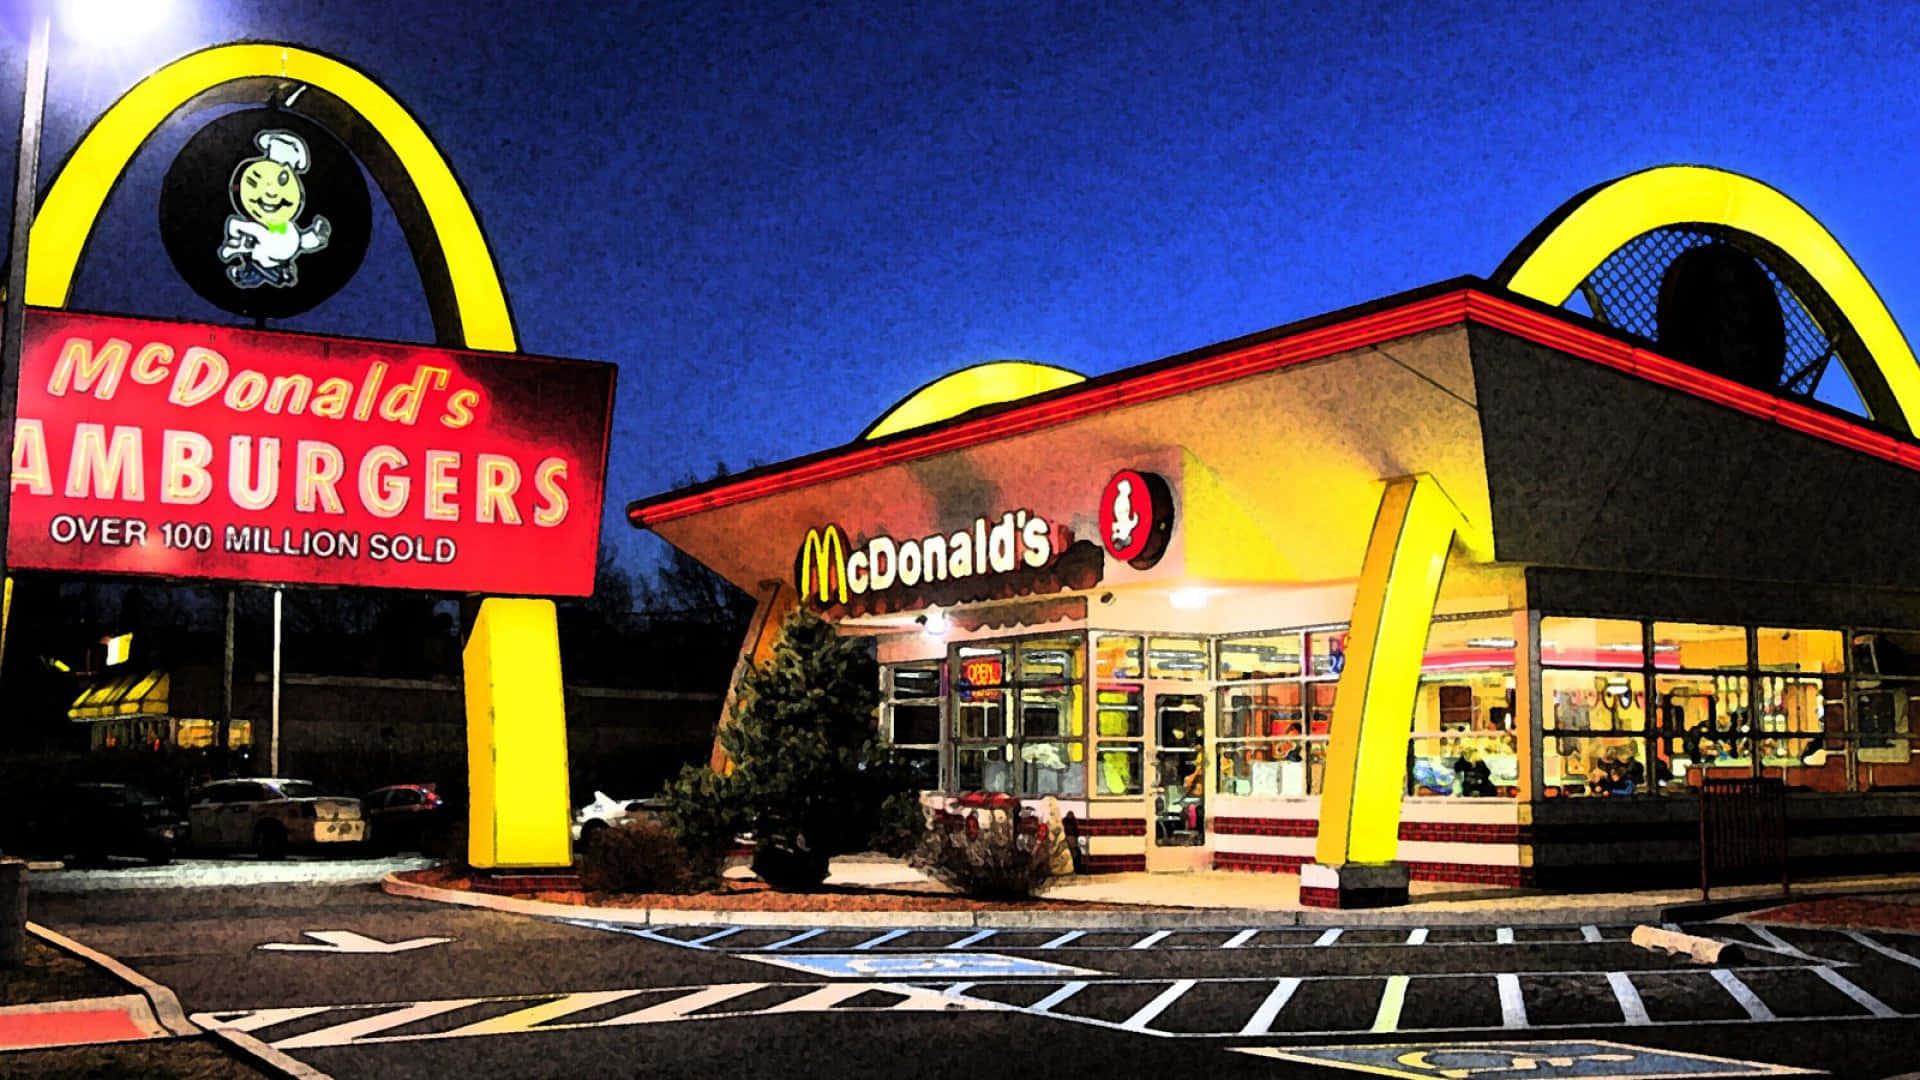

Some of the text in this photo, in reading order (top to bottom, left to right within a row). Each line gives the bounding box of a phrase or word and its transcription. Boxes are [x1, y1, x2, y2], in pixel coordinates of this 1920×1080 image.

[47, 337, 479, 429] McDonald's
[10, 418, 569, 528] AMBURGERS
[50, 514, 457, 563] OVER 100 MILLION SOLD
[801, 509, 1051, 604] McDonald's
